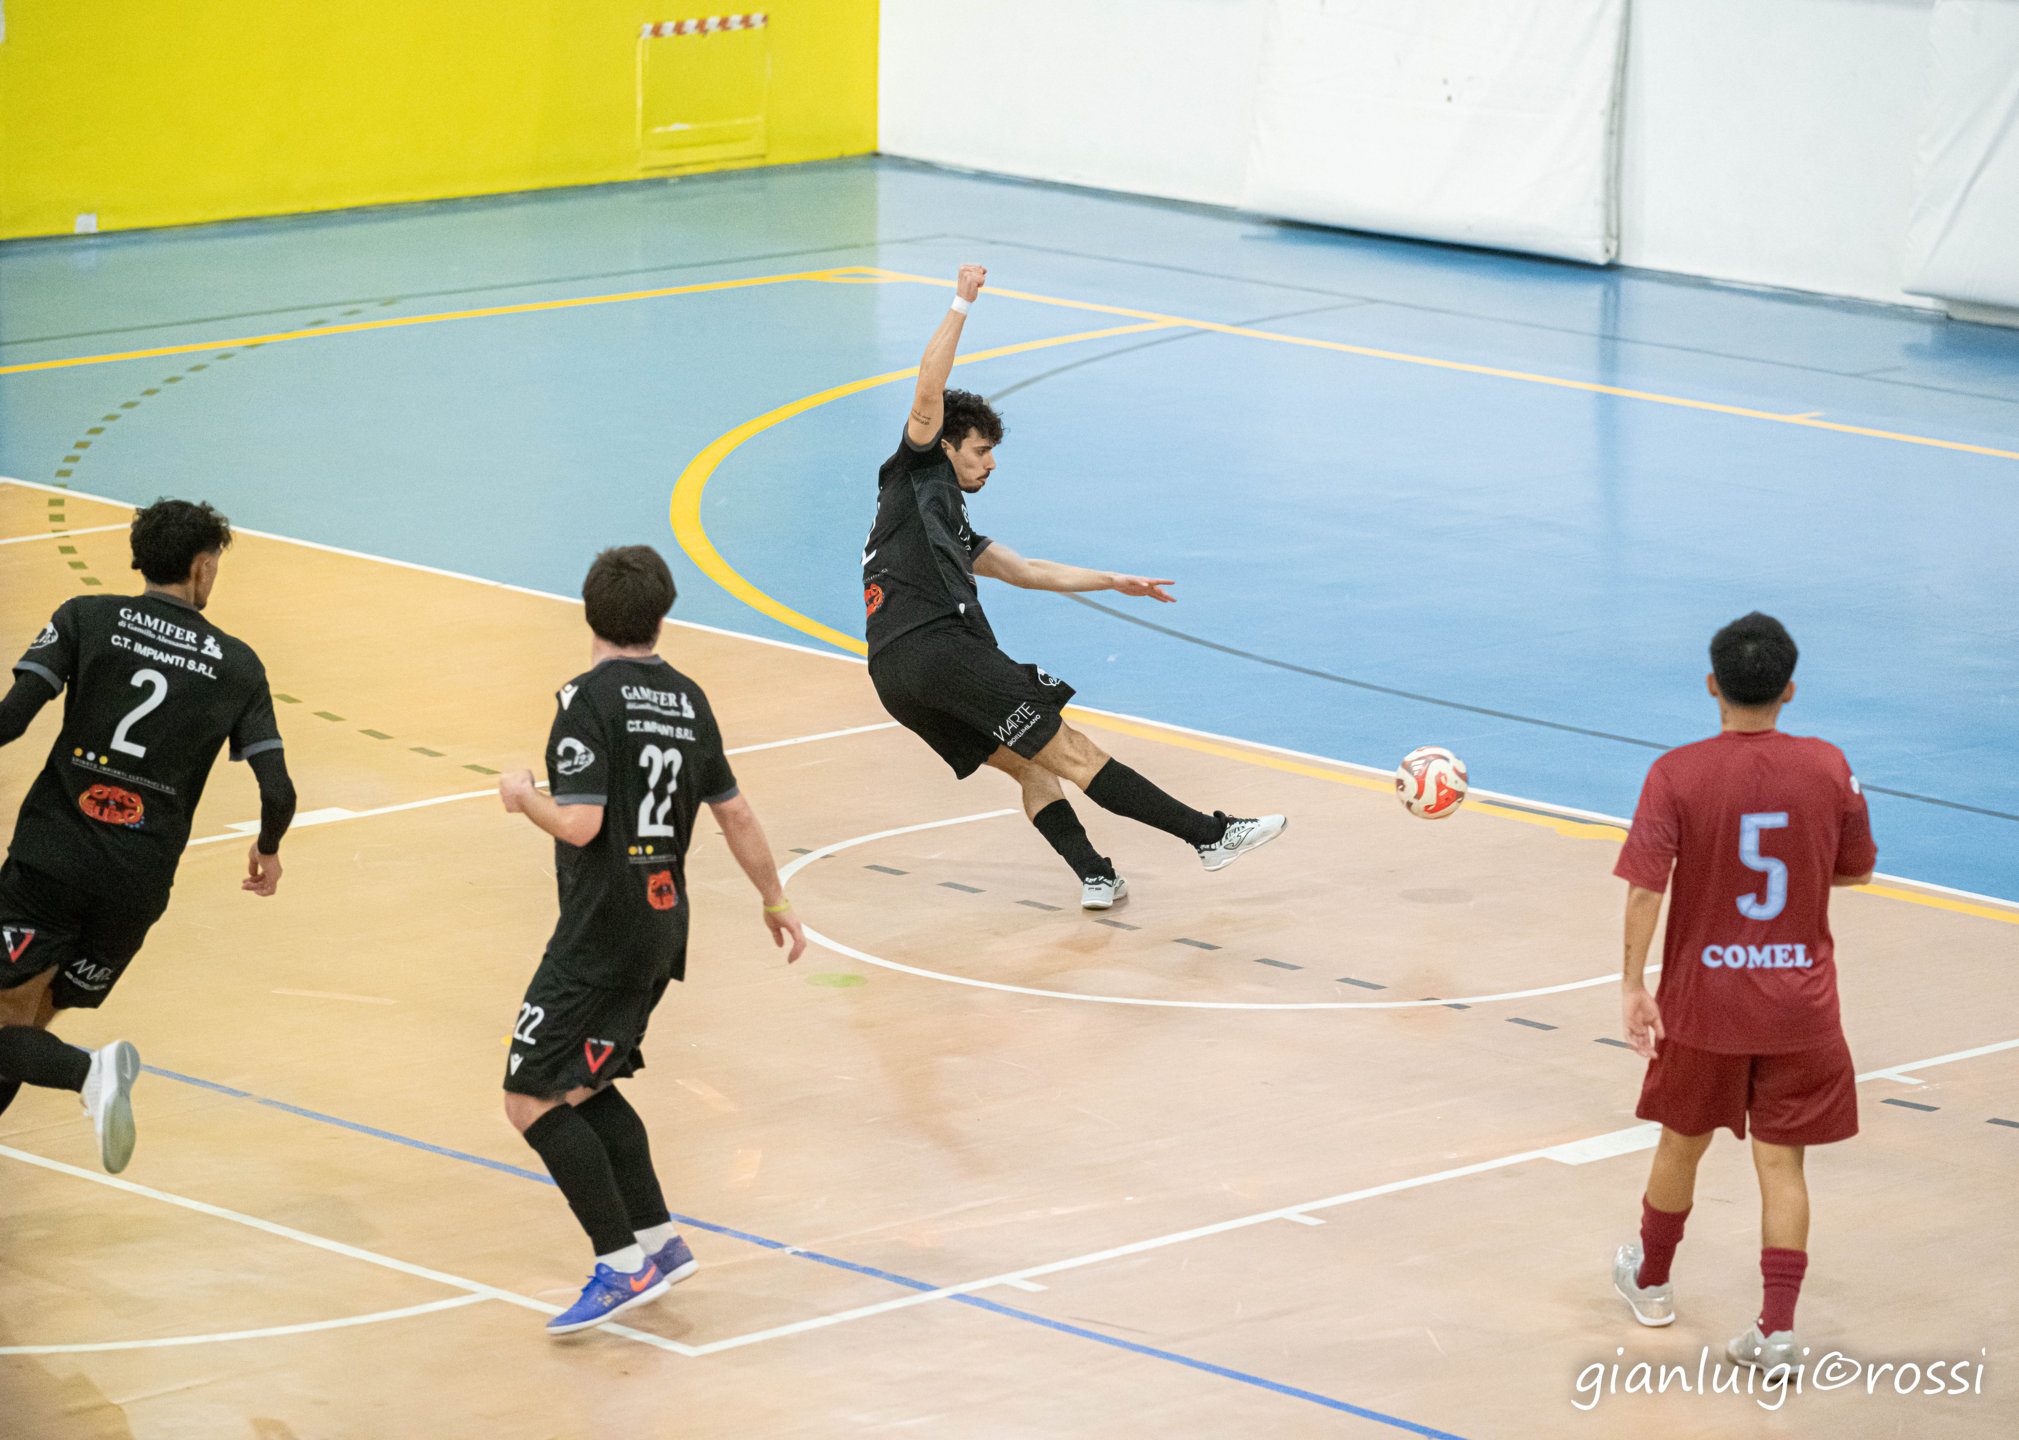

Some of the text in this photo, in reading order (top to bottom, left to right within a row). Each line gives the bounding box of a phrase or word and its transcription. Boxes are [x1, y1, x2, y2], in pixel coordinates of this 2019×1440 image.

[119, 607, 197, 644] GAMIFER
[111, 634, 131, 650] C.T.
[133, 642, 185, 668] IMPIANTI
[110, 668, 168, 758] 2
[637, 744, 683, 837] 22
[1736, 812, 1788, 920] 5
[1702, 944, 1813, 969] COMEL
[513, 1002, 545, 1045] 22
